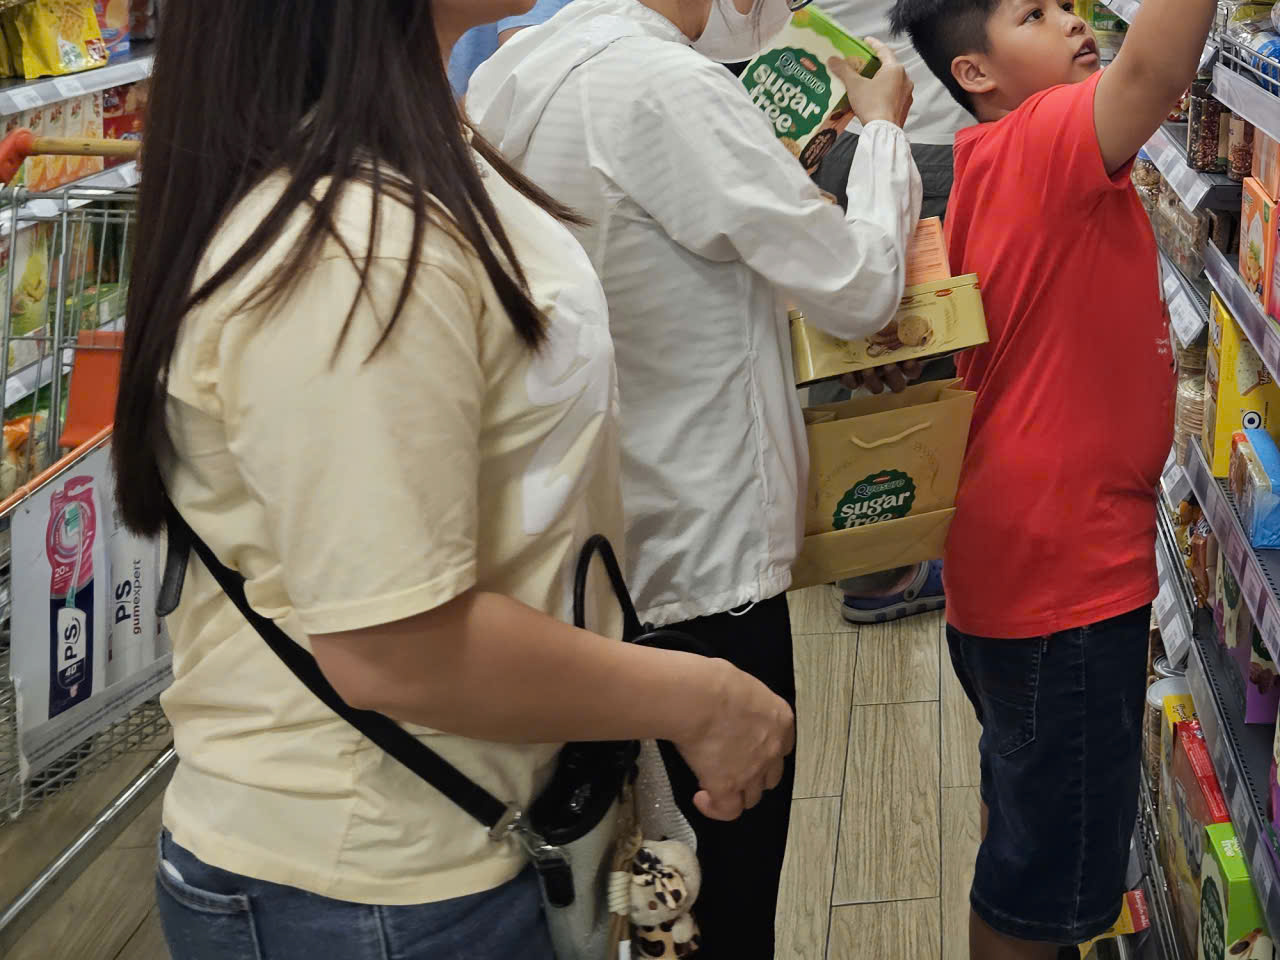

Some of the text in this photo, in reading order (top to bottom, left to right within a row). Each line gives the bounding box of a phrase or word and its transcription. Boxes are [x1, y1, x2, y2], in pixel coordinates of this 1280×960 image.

[749, 83, 793, 134] free
[752, 63, 821, 120] sugar
[840, 491, 911, 518] sugar
[854, 478, 906, 499] Quasure
[115, 579, 132, 625] P/S
[133, 559, 143, 636] gumexpert
[64, 624, 78, 662] P/S
